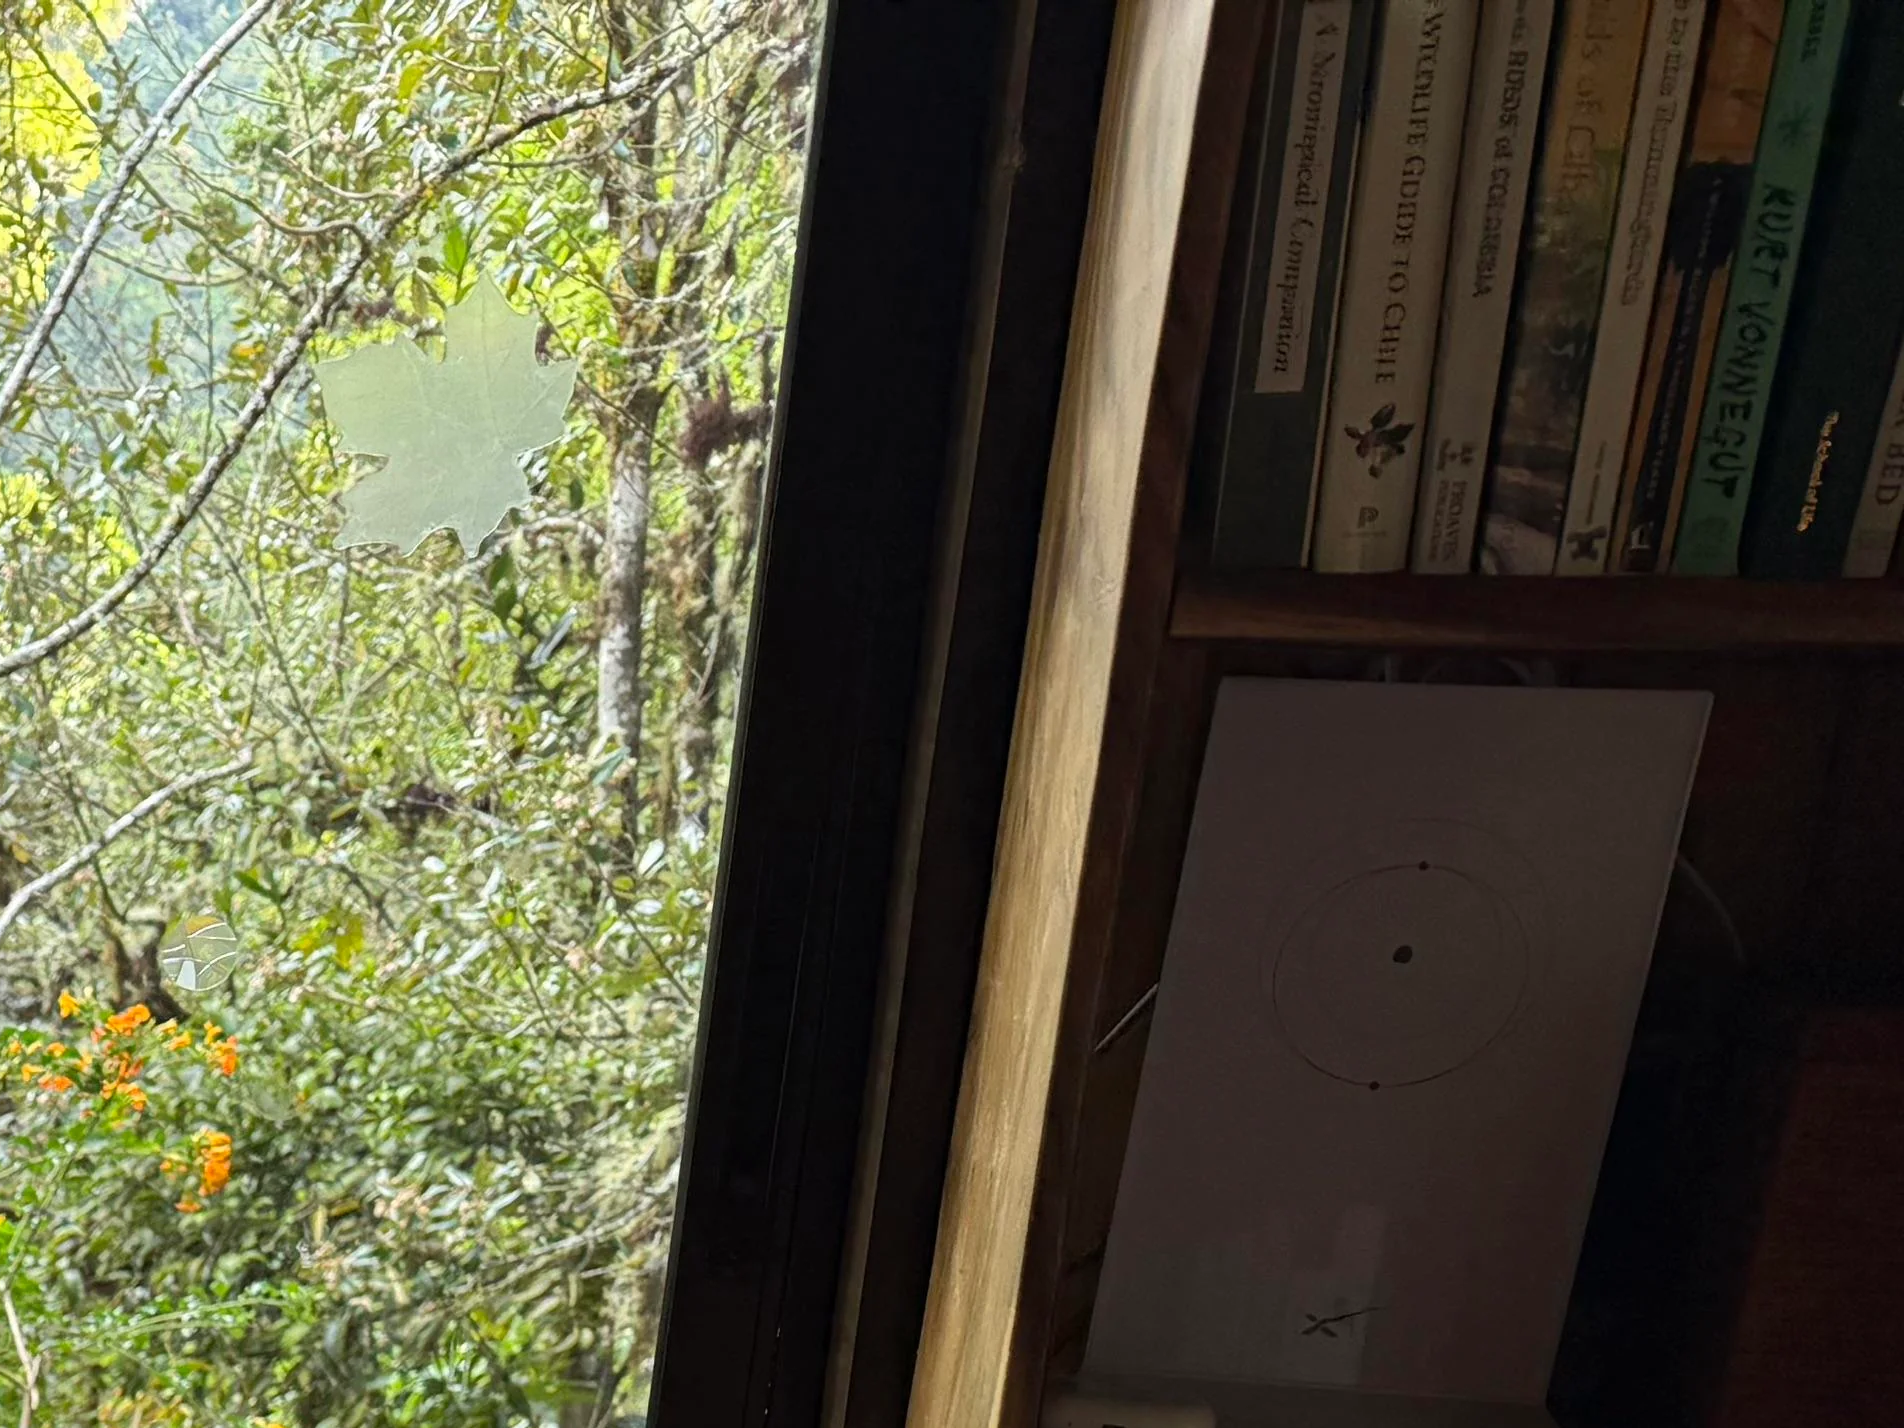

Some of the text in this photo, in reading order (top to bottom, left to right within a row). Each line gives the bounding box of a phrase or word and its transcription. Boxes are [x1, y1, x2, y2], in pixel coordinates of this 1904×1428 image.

[1393, 155, 1426, 245] GUIDE
[1387, 257, 1410, 293] TO
[1375, 303, 1407, 385] CHILE
[1700, 183, 1796, 498] KURT VONNEGUT
